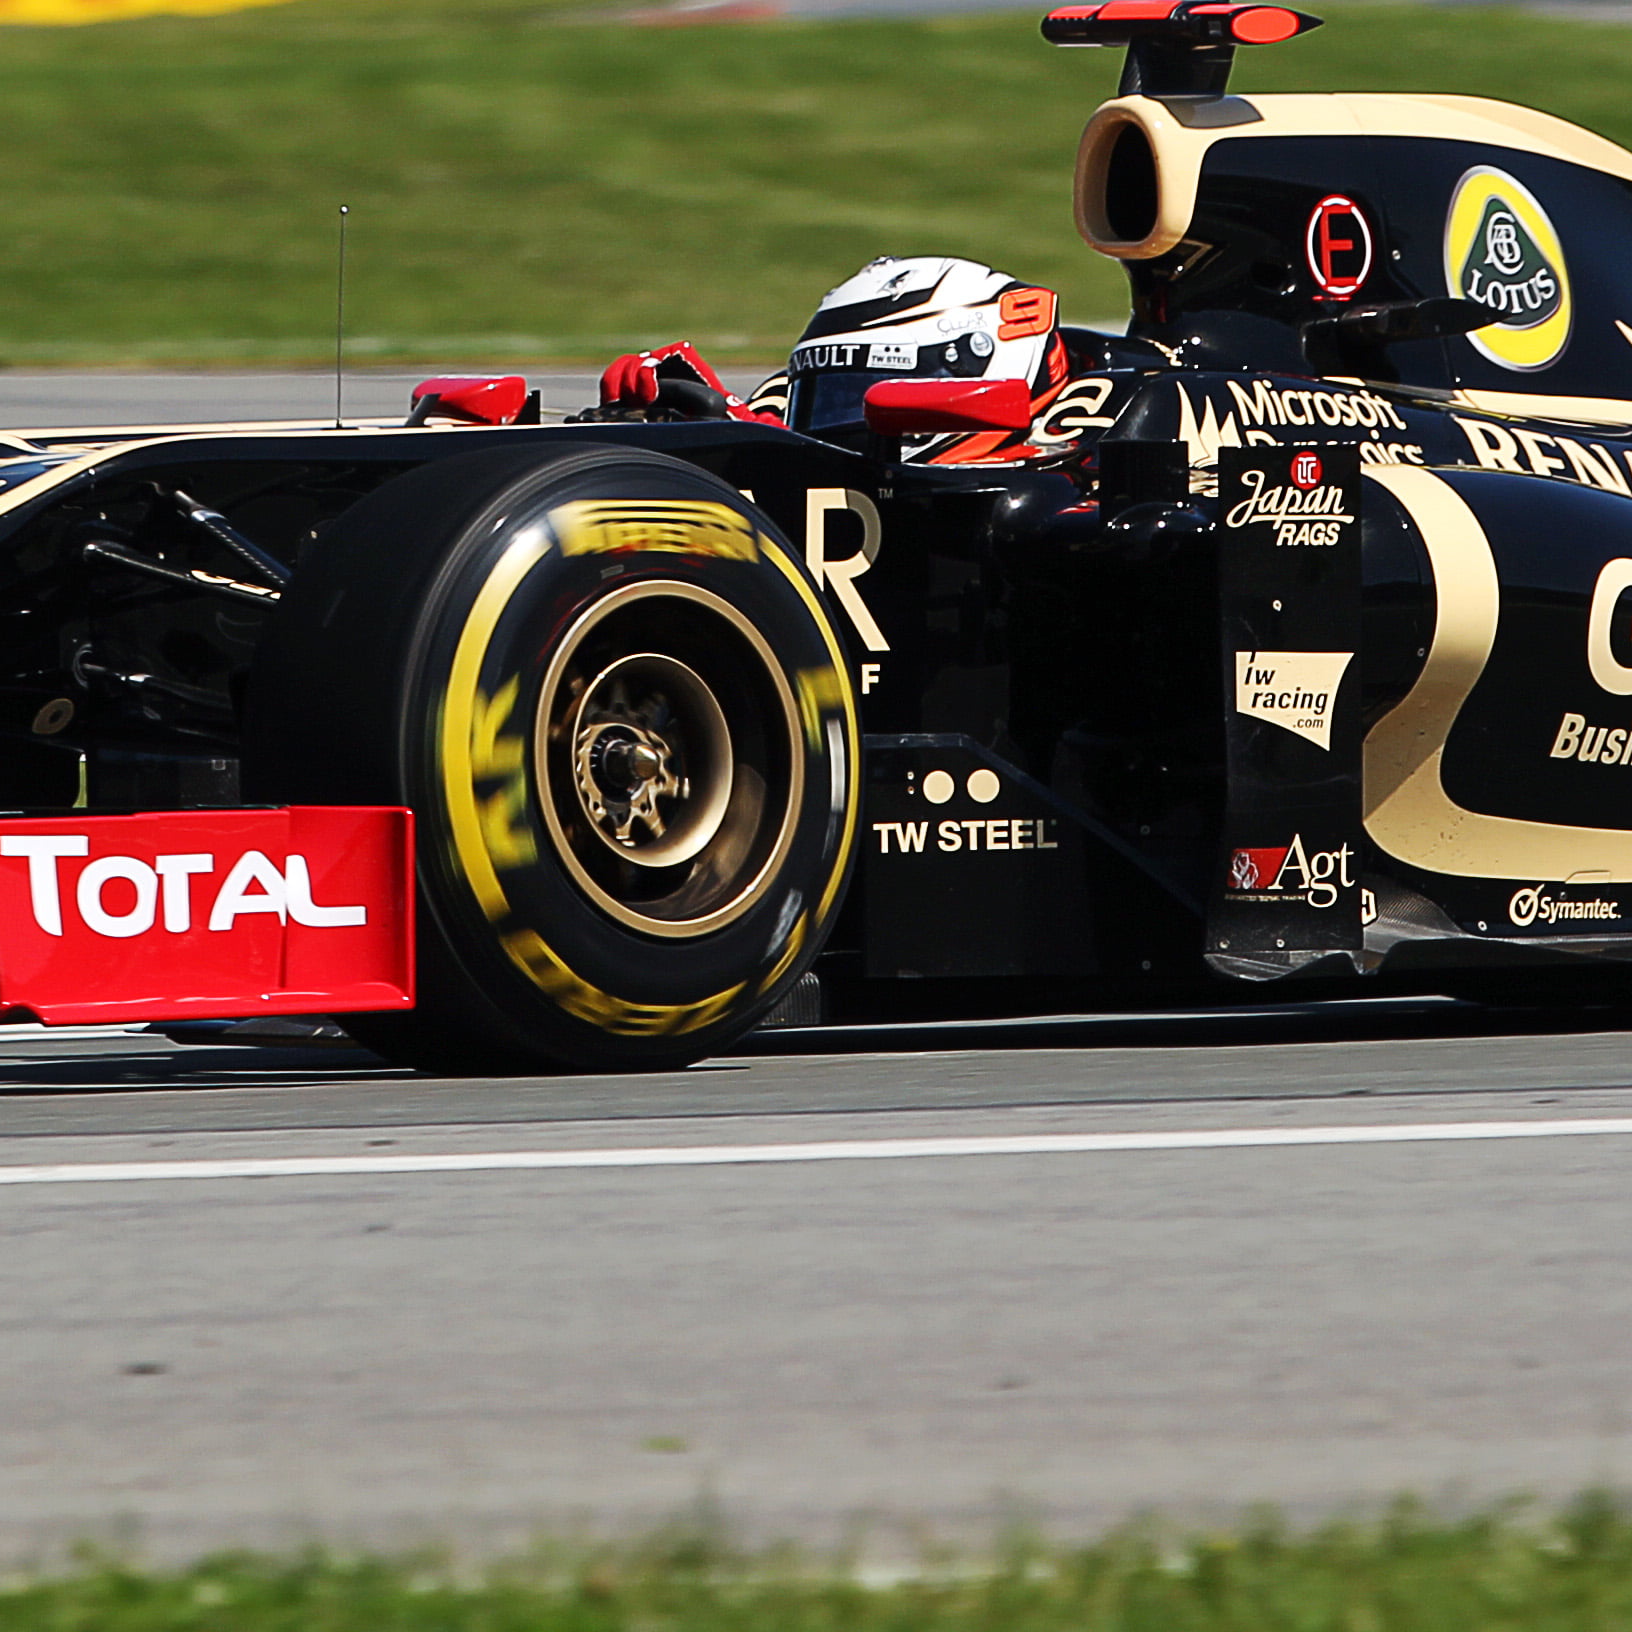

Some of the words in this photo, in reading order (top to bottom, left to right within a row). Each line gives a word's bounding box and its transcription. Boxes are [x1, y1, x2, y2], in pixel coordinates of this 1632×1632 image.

[1466, 268, 1557, 314] LOTUS
[997, 286, 1056, 343] 9
[1226, 378, 1408, 431] Microsoft
[1226, 469, 1345, 531] Japan
[1276, 522, 1341, 547] RAGS
[1251, 686, 1329, 716] racing
[1292, 718, 1324, 729] .com
[872, 821, 929, 854] TW
[937, 819, 1058, 853] STEEL
[1267, 832, 1356, 908] Agt
